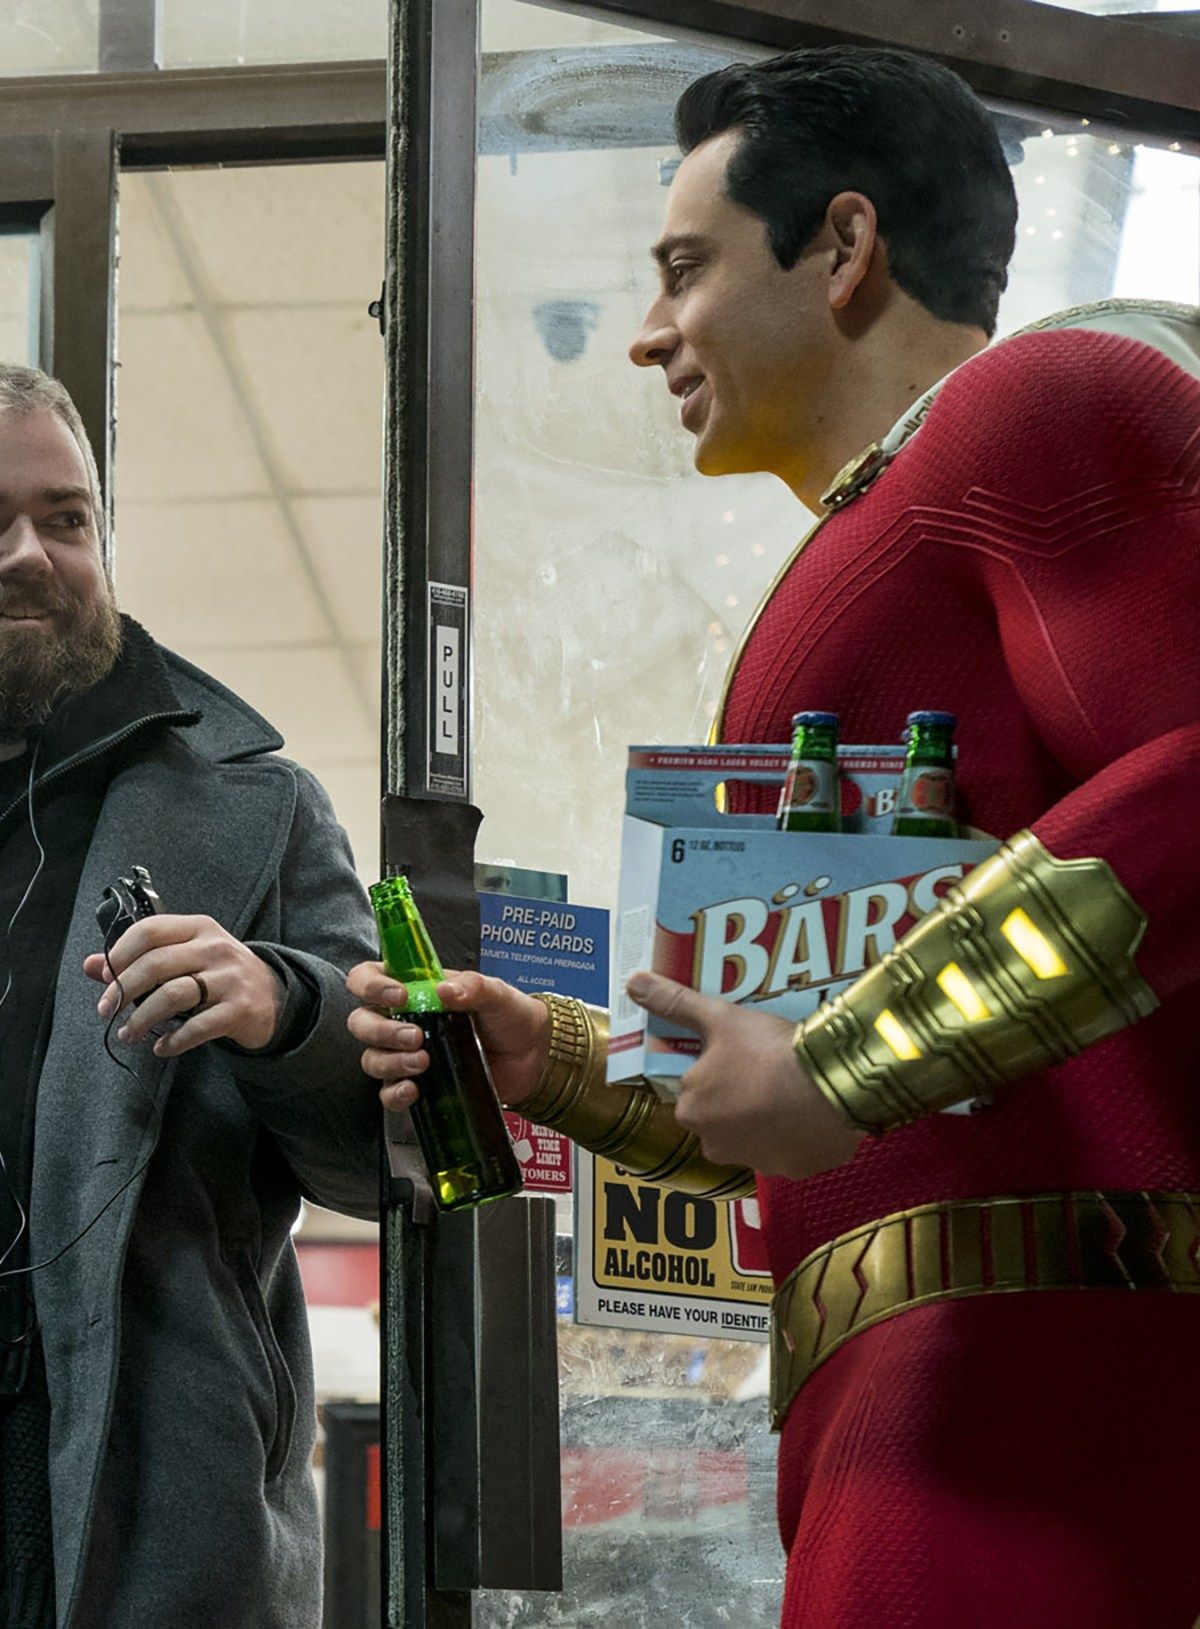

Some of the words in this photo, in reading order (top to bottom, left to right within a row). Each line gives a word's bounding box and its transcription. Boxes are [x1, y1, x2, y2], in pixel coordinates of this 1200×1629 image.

[442, 645, 453, 738] PULL
[672, 838, 686, 864] 6
[502, 905, 576, 930] PRE-PAID
[480, 923, 536, 946] PHONE
[540, 932, 594, 954] CARDS
[480, 948, 510, 960] TARJETA
[511, 952, 553, 966] TELEFONICA
[554, 958, 596, 971] PREPAGADA
[517, 975, 528, 985] ALL
[529, 976, 555, 987] ACCESS
[537, 1138, 560, 1152] TIME
[536, 1152, 561, 1166] LIMIT
[521, 1167, 566, 1182] TOMERS
[604, 1182, 717, 1250] NO
[604, 1247, 715, 1287] ALCOHOL
[730, 1280, 746, 1292] STATE
[746, 1282, 758, 1292] LAW
[598, 1298, 645, 1315] PLEASE
[649, 1305, 680, 1320] HAVE
[684, 1309, 718, 1324] YOUR
[721, 1312, 768, 1329] IDENTIF
